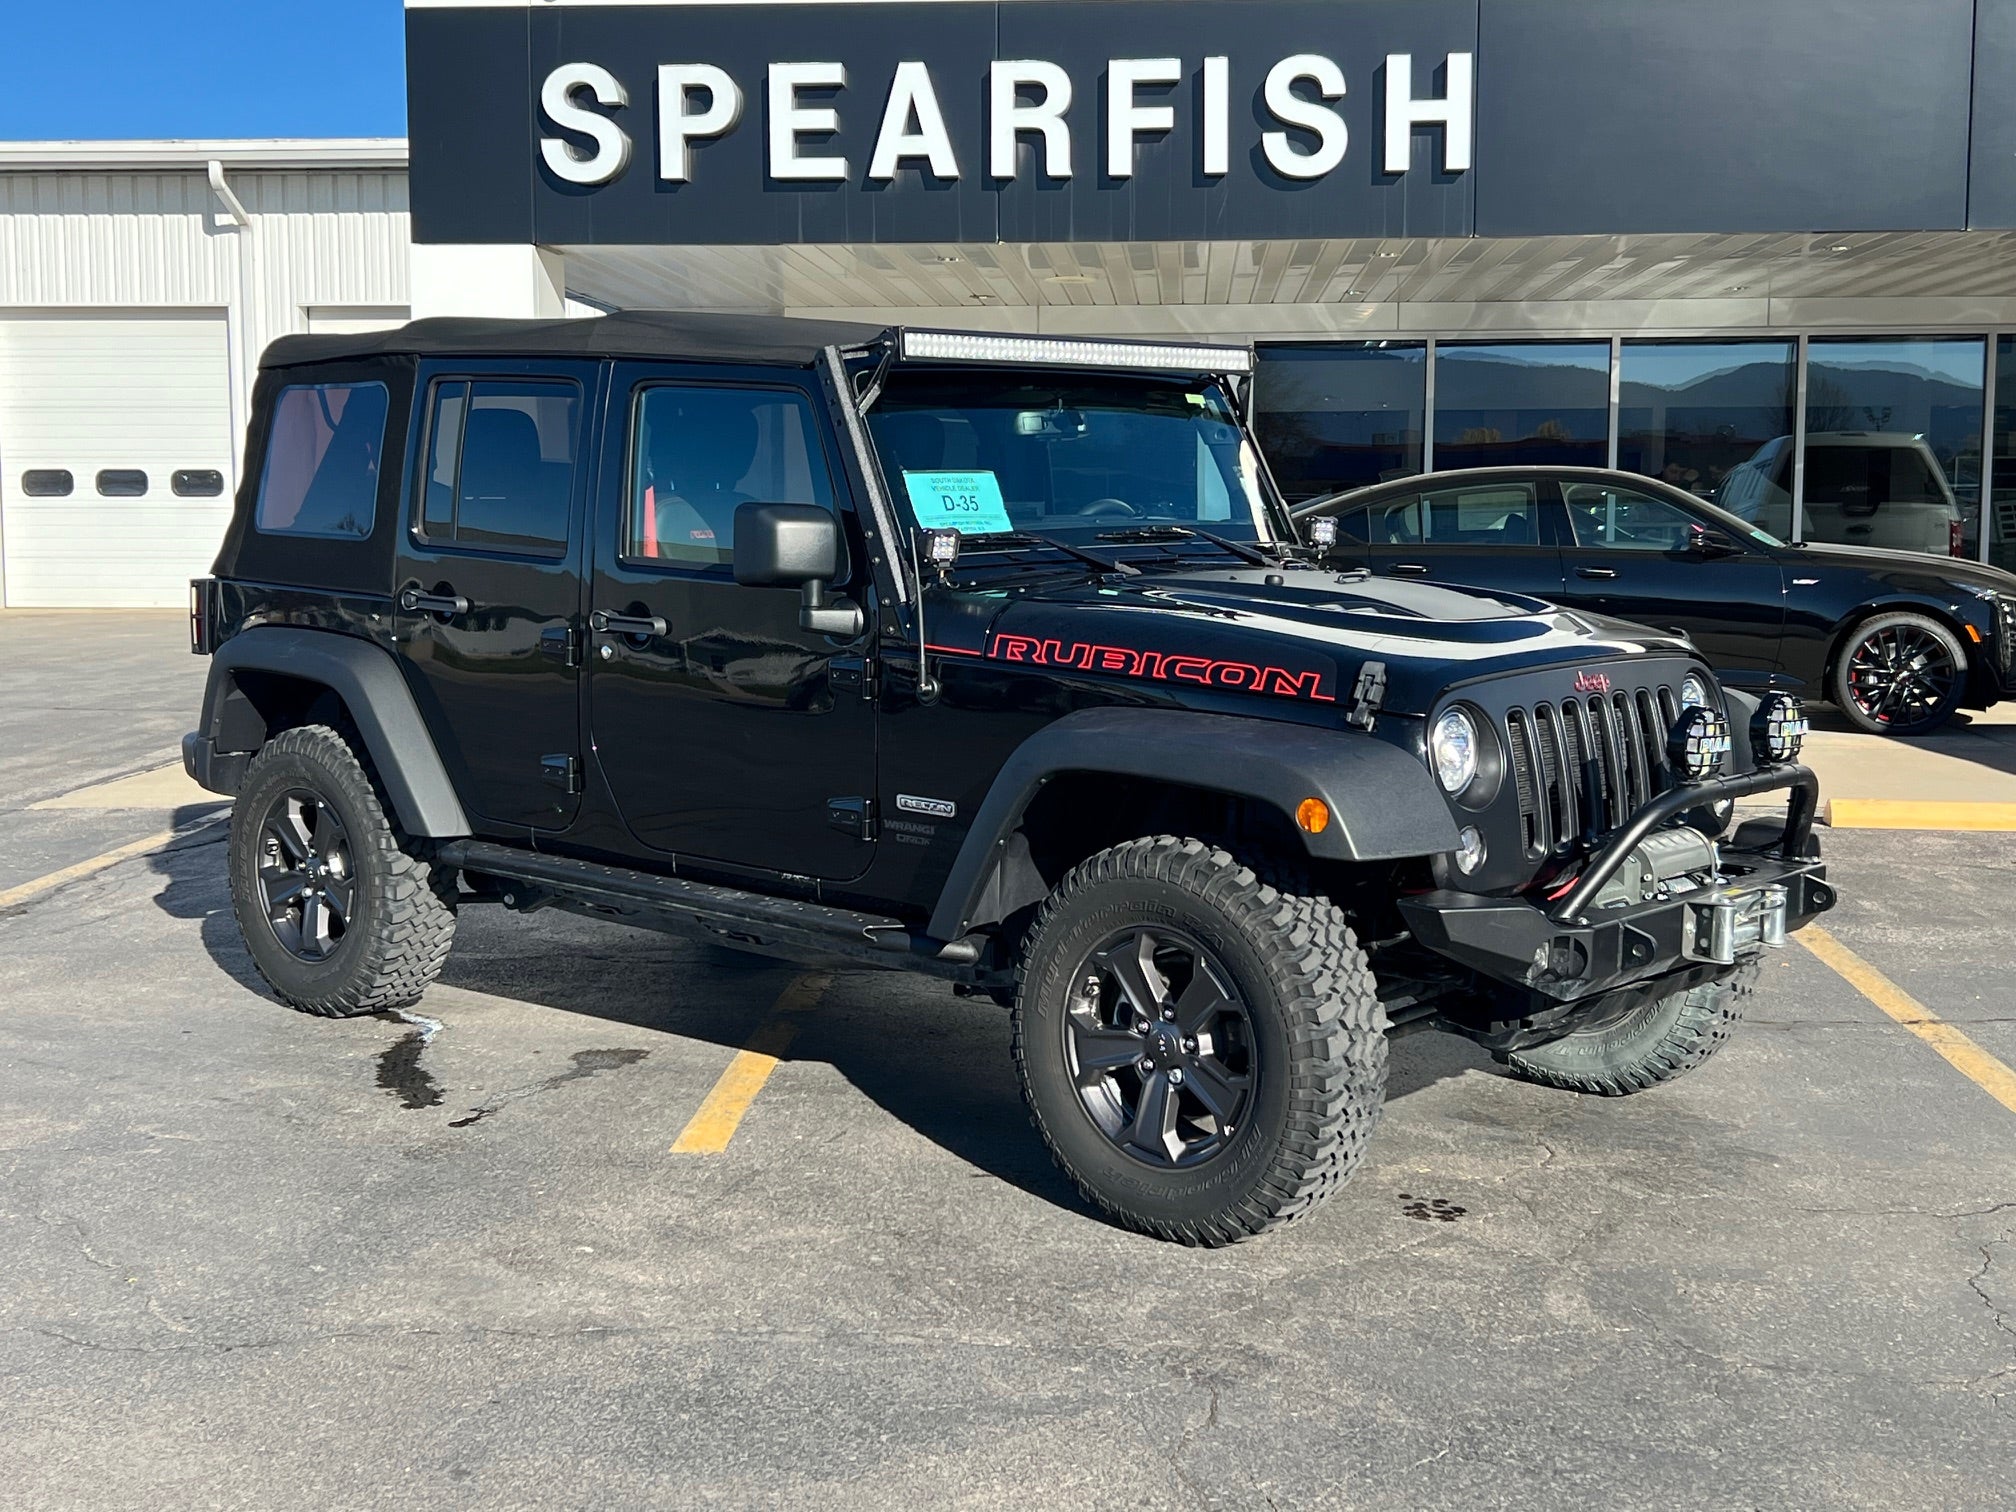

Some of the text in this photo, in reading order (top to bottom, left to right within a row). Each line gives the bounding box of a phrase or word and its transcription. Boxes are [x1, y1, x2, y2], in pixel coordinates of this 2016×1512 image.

[539, 51, 1474, 186] SPEARFISH
[942, 495, 979, 512] D-35
[988, 633, 1335, 701] RUBICON
[1574, 670, 1611, 693] Jeep
[1781, 720, 1809, 736] PIAA
[1700, 735, 1732, 754] PIAA
[900, 798, 952, 813] RECON
